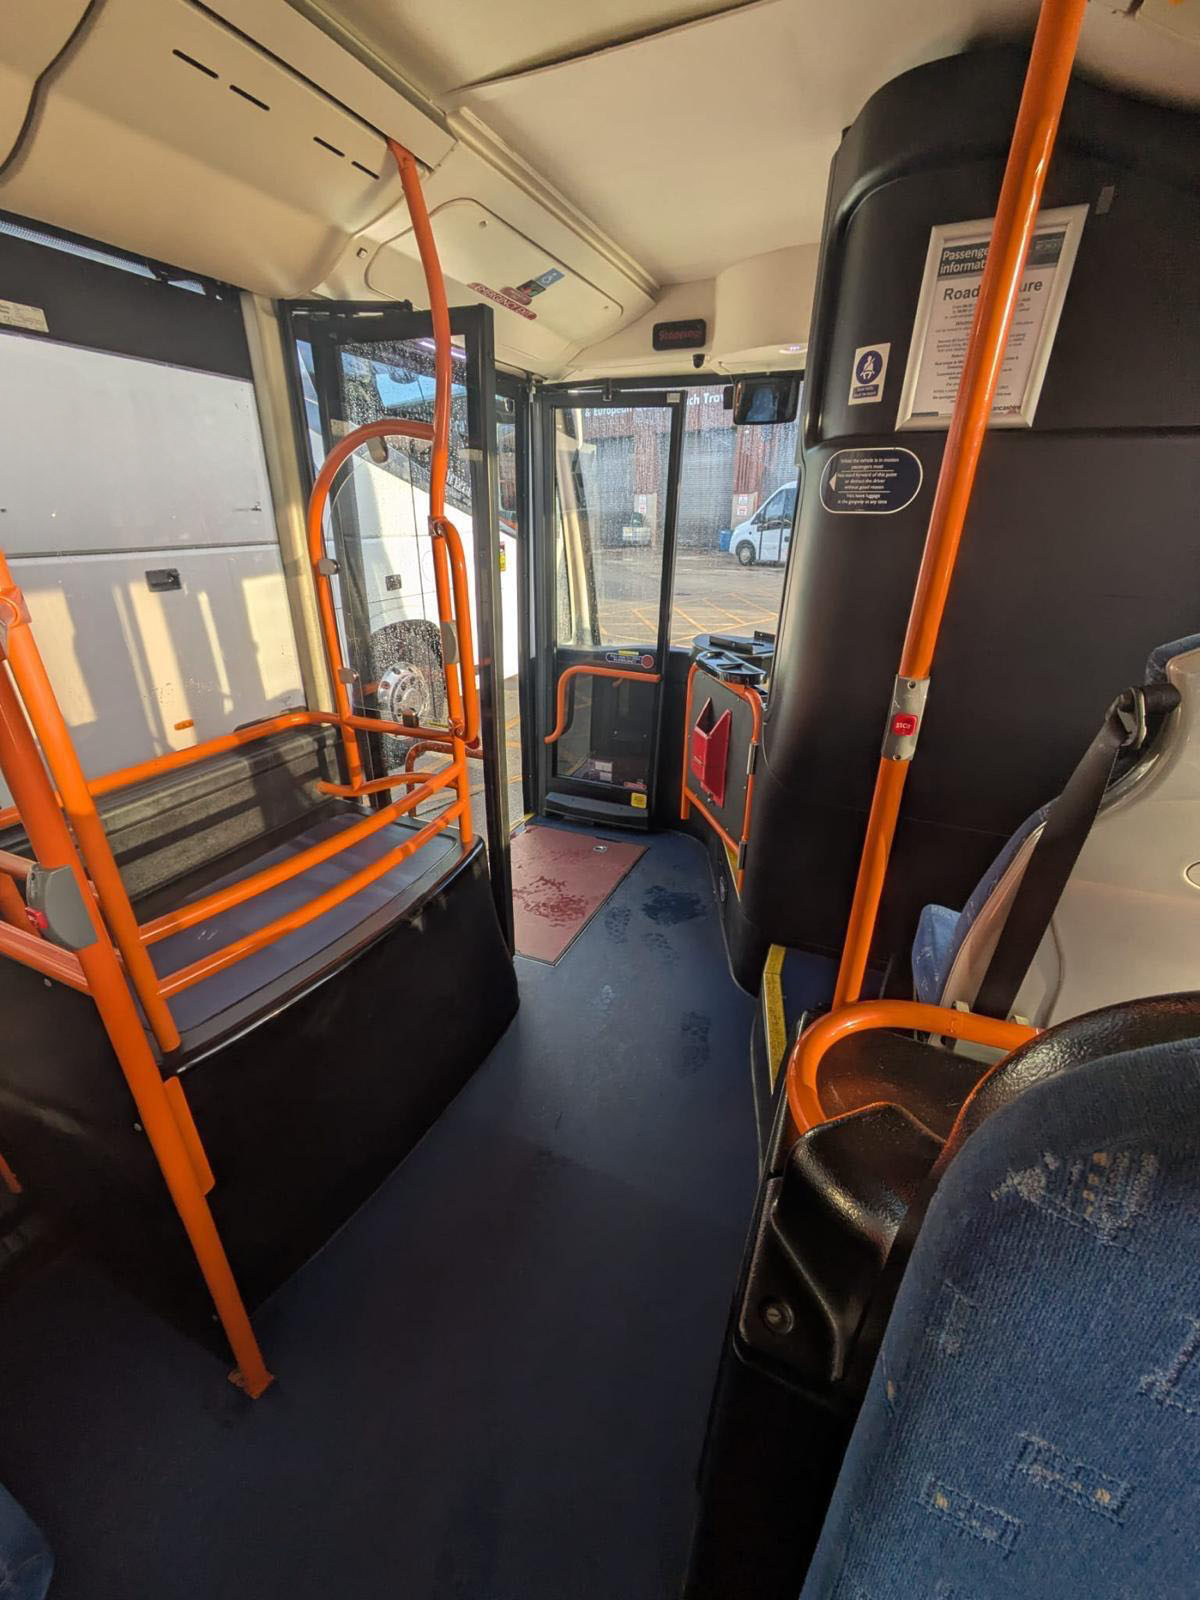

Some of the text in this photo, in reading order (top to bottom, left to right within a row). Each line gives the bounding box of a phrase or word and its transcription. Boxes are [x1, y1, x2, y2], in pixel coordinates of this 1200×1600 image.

[942, 246, 991, 260] Passenge
[939, 260, 986, 274] informat
[943, 285, 981, 301] Road
